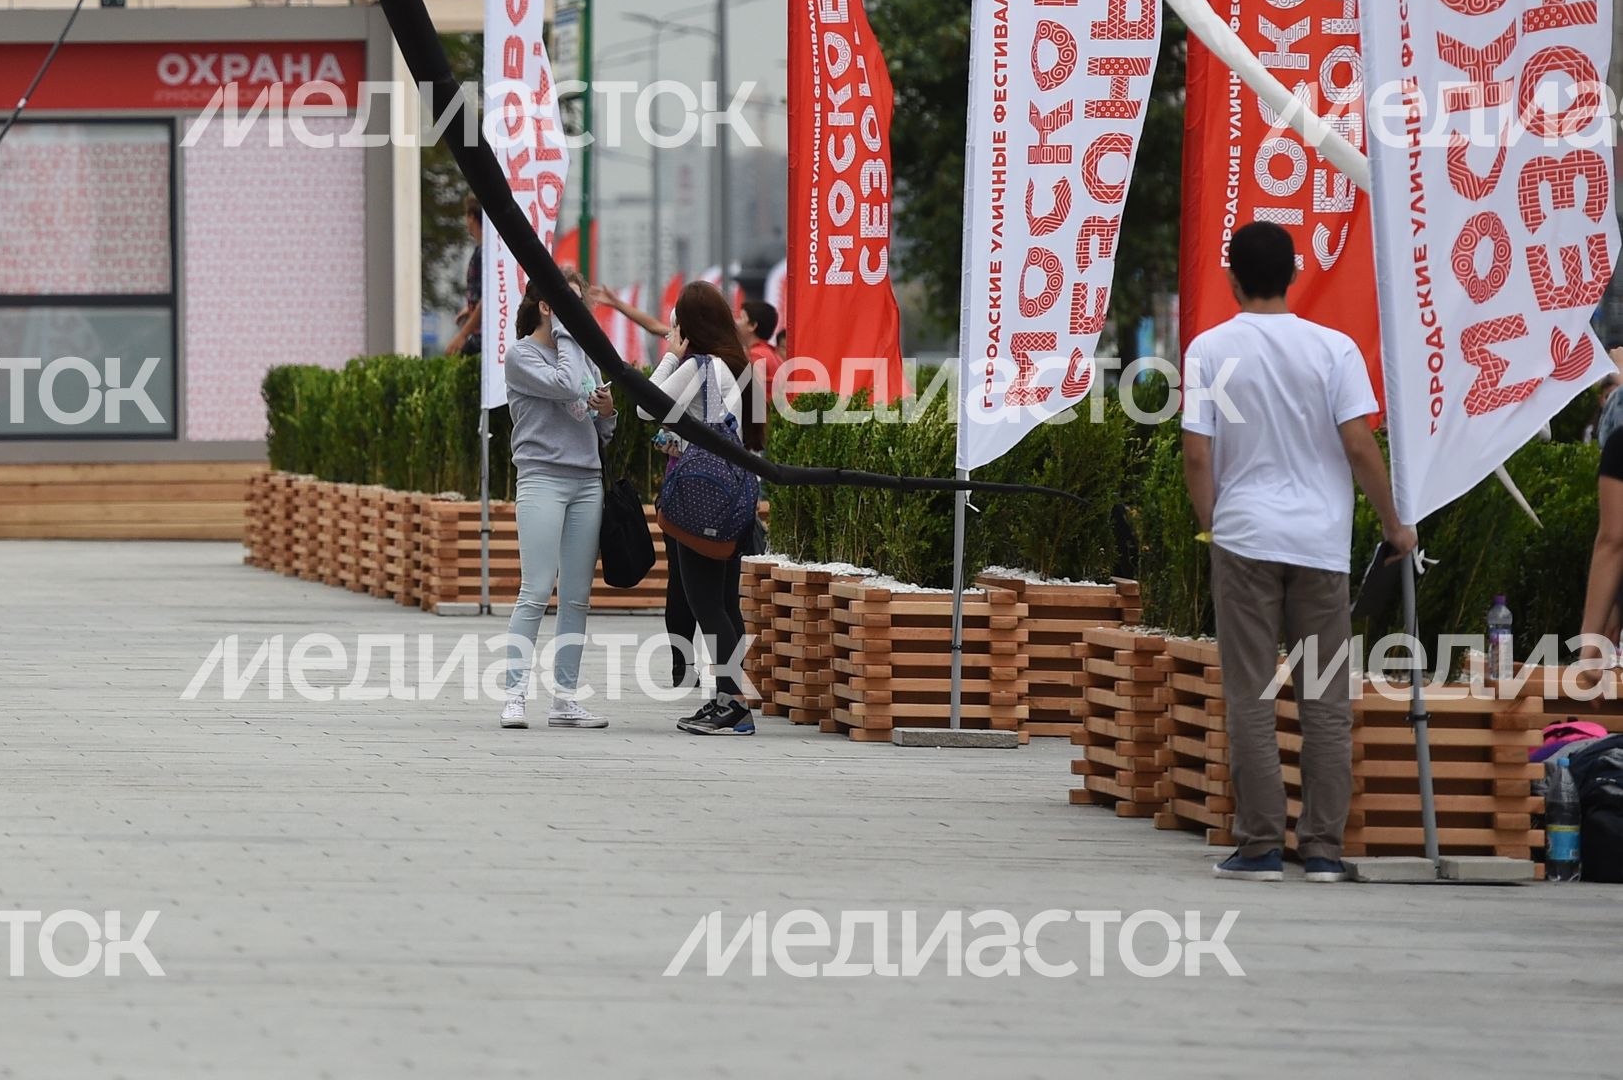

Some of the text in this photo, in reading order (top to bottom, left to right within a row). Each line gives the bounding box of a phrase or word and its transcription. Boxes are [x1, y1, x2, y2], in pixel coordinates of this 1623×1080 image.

[157, 52, 346, 87] ОХРАНА
[1229, 70, 1242, 140] УЛИЧН
[808, 0, 821, 285] ГОРОДСКИЕ УЛИЧНЫЕ ФЕСТИВАЛИ
[991, 130, 1007, 253] УЛИЧНЫЕ
[1401, 75, 1427, 237] УЛИЧНЫЕ
